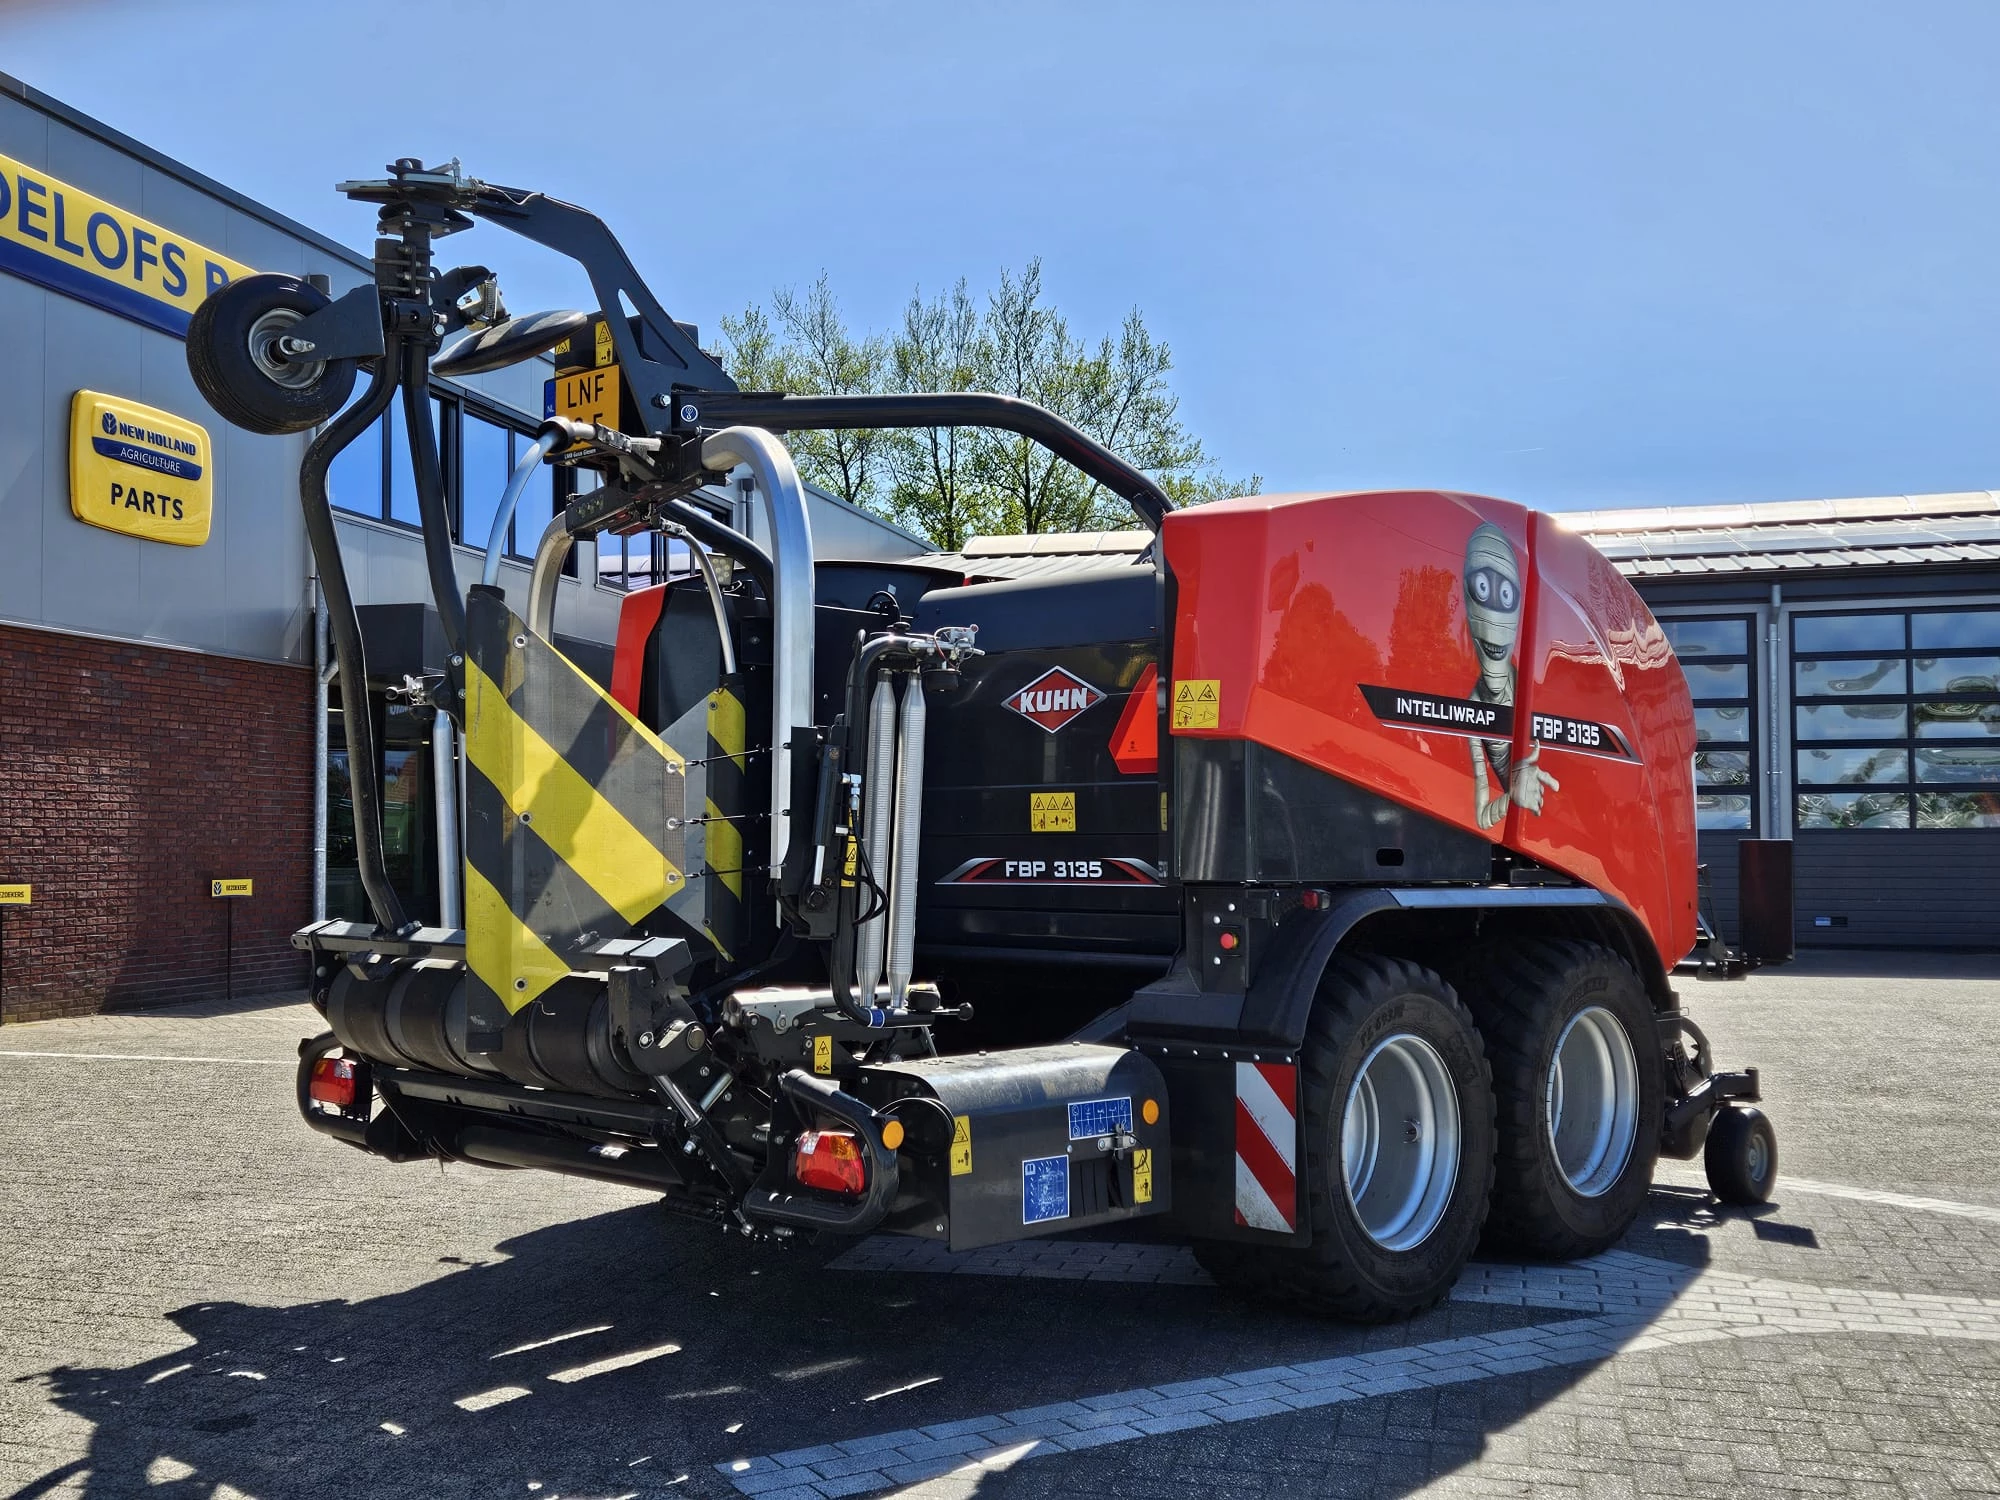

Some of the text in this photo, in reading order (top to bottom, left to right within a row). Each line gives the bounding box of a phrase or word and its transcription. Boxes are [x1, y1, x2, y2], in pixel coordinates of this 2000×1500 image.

[0, 171, 187, 298] ELOFS
[567, 374, 605, 408] LNF
[119, 422, 197, 457] NEW HOLLAND
[120, 447, 181, 473] AGRICULTURE
[111, 482, 184, 521] PARTS
[1020, 687, 1088, 713] KUHN
[1396, 697, 1496, 726] INTELLIWRAP
[1533, 715, 1600, 746] FBP 3135
[1005, 861, 1102, 878] FBP 3135
